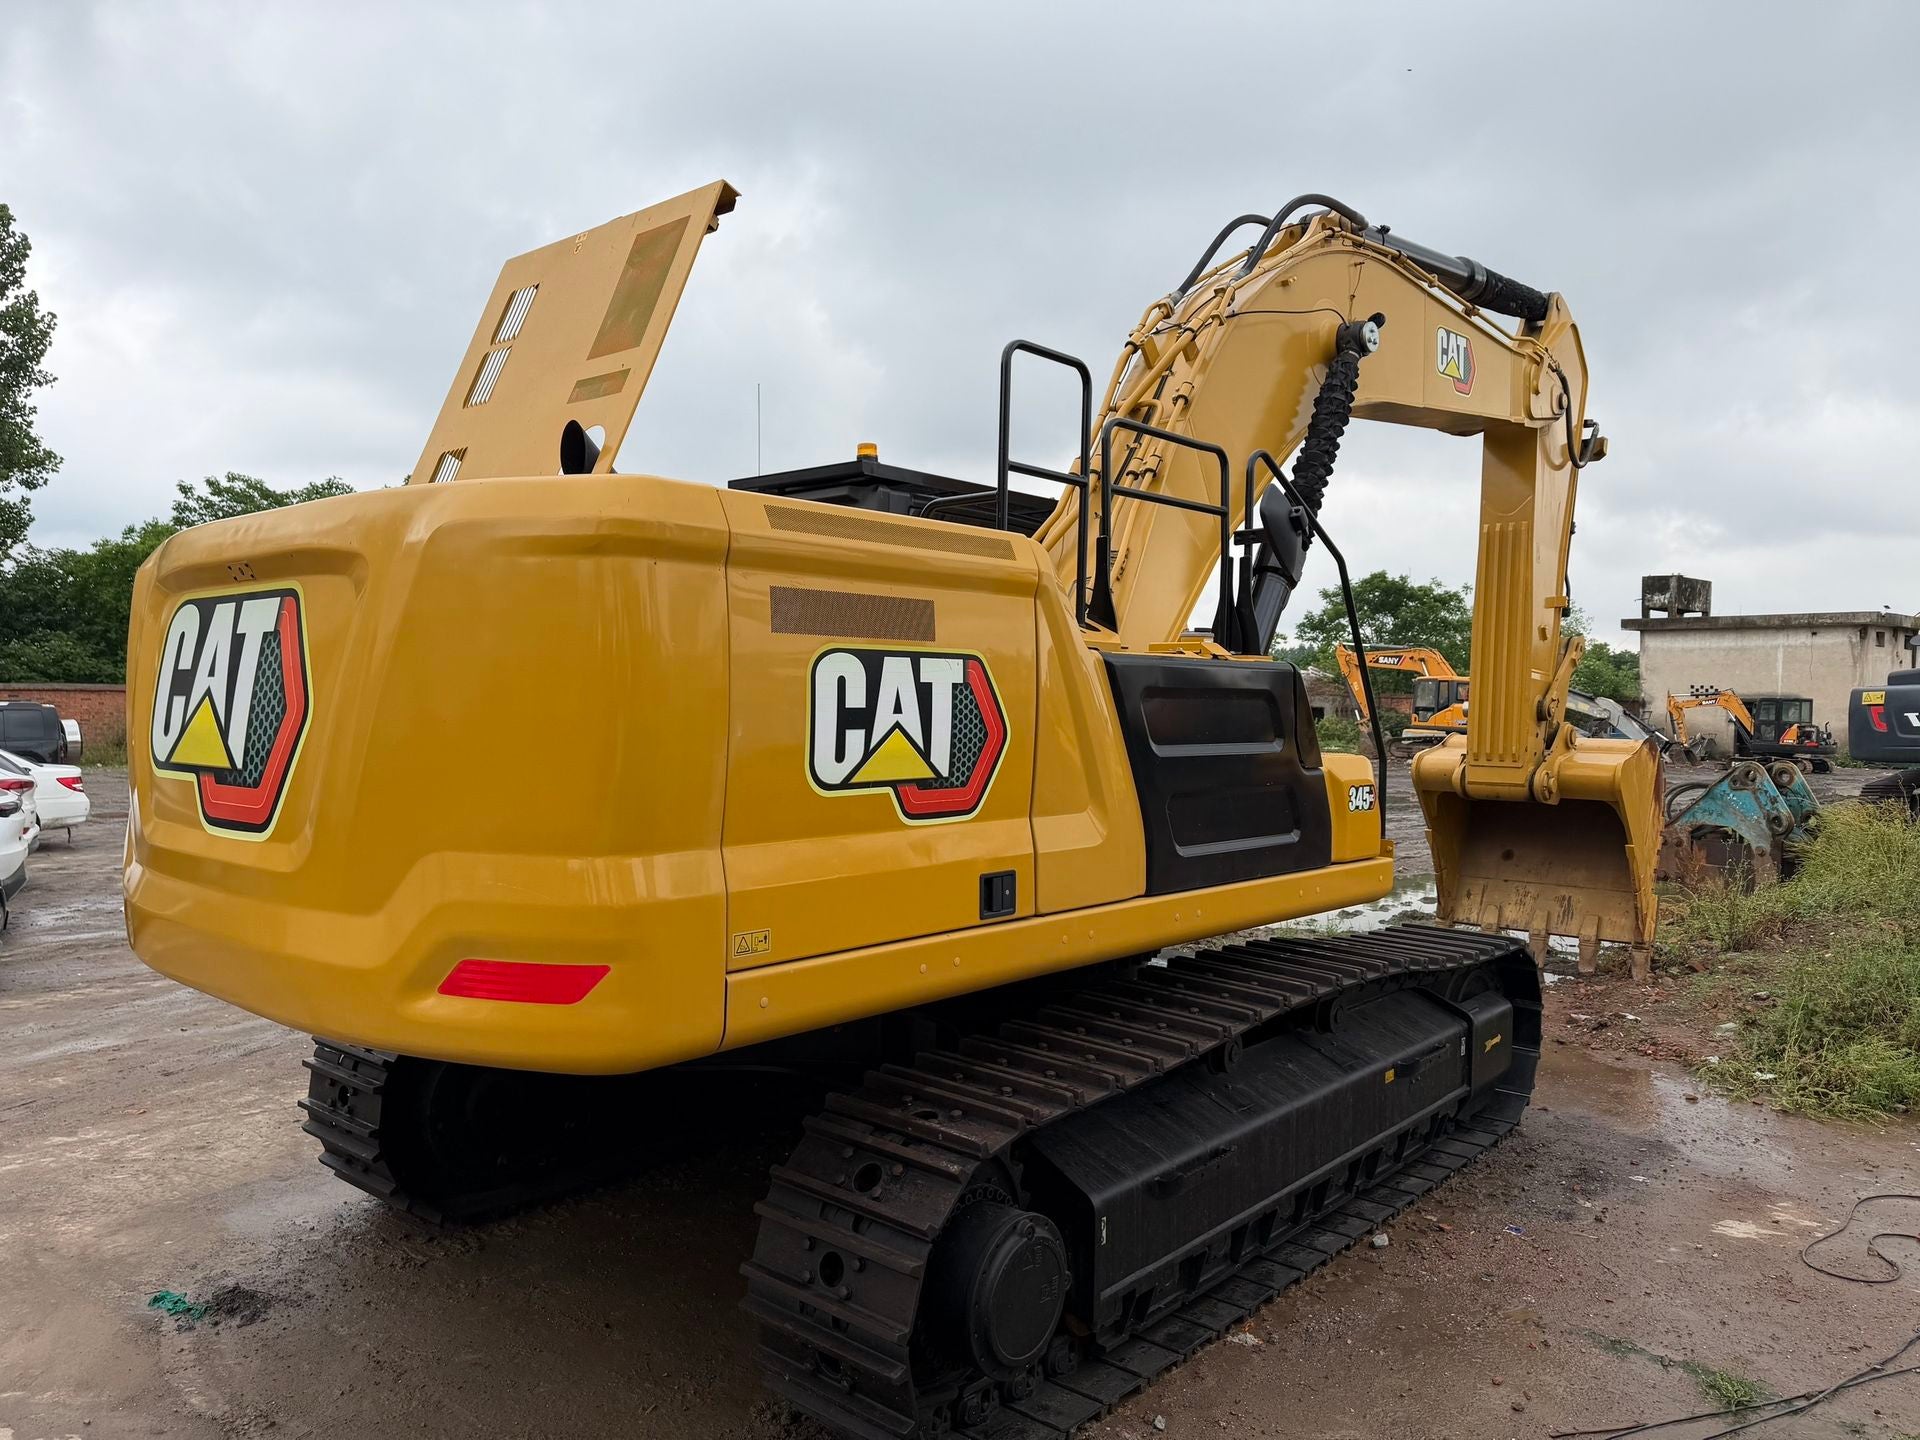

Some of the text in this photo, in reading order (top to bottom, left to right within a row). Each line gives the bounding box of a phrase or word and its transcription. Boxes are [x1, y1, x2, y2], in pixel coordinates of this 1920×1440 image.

[1437, 327, 1467, 380] CAT
[152, 597, 281, 770] CAT
[1378, 656, 1399, 665] SANY
[814, 652, 964, 785] CAT
[1349, 786, 1370, 811] 345
